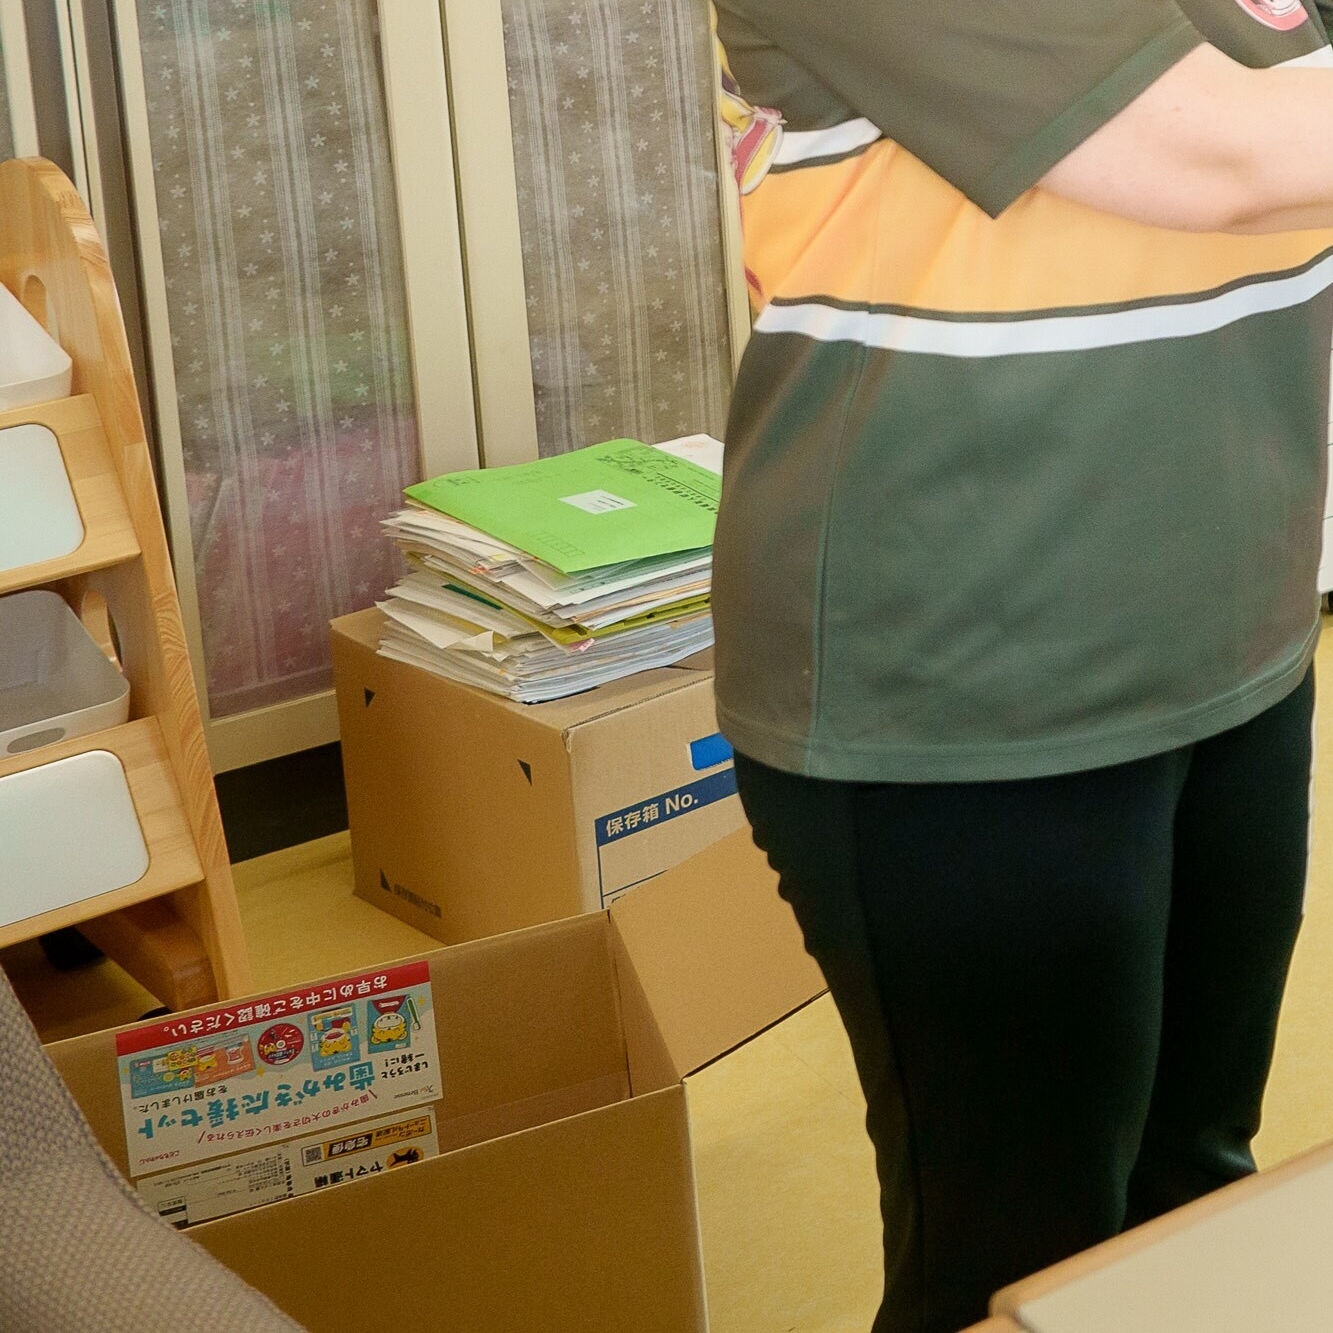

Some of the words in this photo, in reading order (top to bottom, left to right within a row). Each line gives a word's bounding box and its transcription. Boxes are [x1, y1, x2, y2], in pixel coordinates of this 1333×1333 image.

[604, 802, 660, 838] 保存箱
[665, 791, 700, 817] No.
[163, 974, 388, 1037] お早めに中をご確認ください。
[380, 1061, 429, 1080] しまじろうと
[133, 1085, 228, 1114] をお届けしました。
[138, 1061, 375, 1140] 歯みがき応援セット
[332, 1136, 369, 1155] 宅急便
